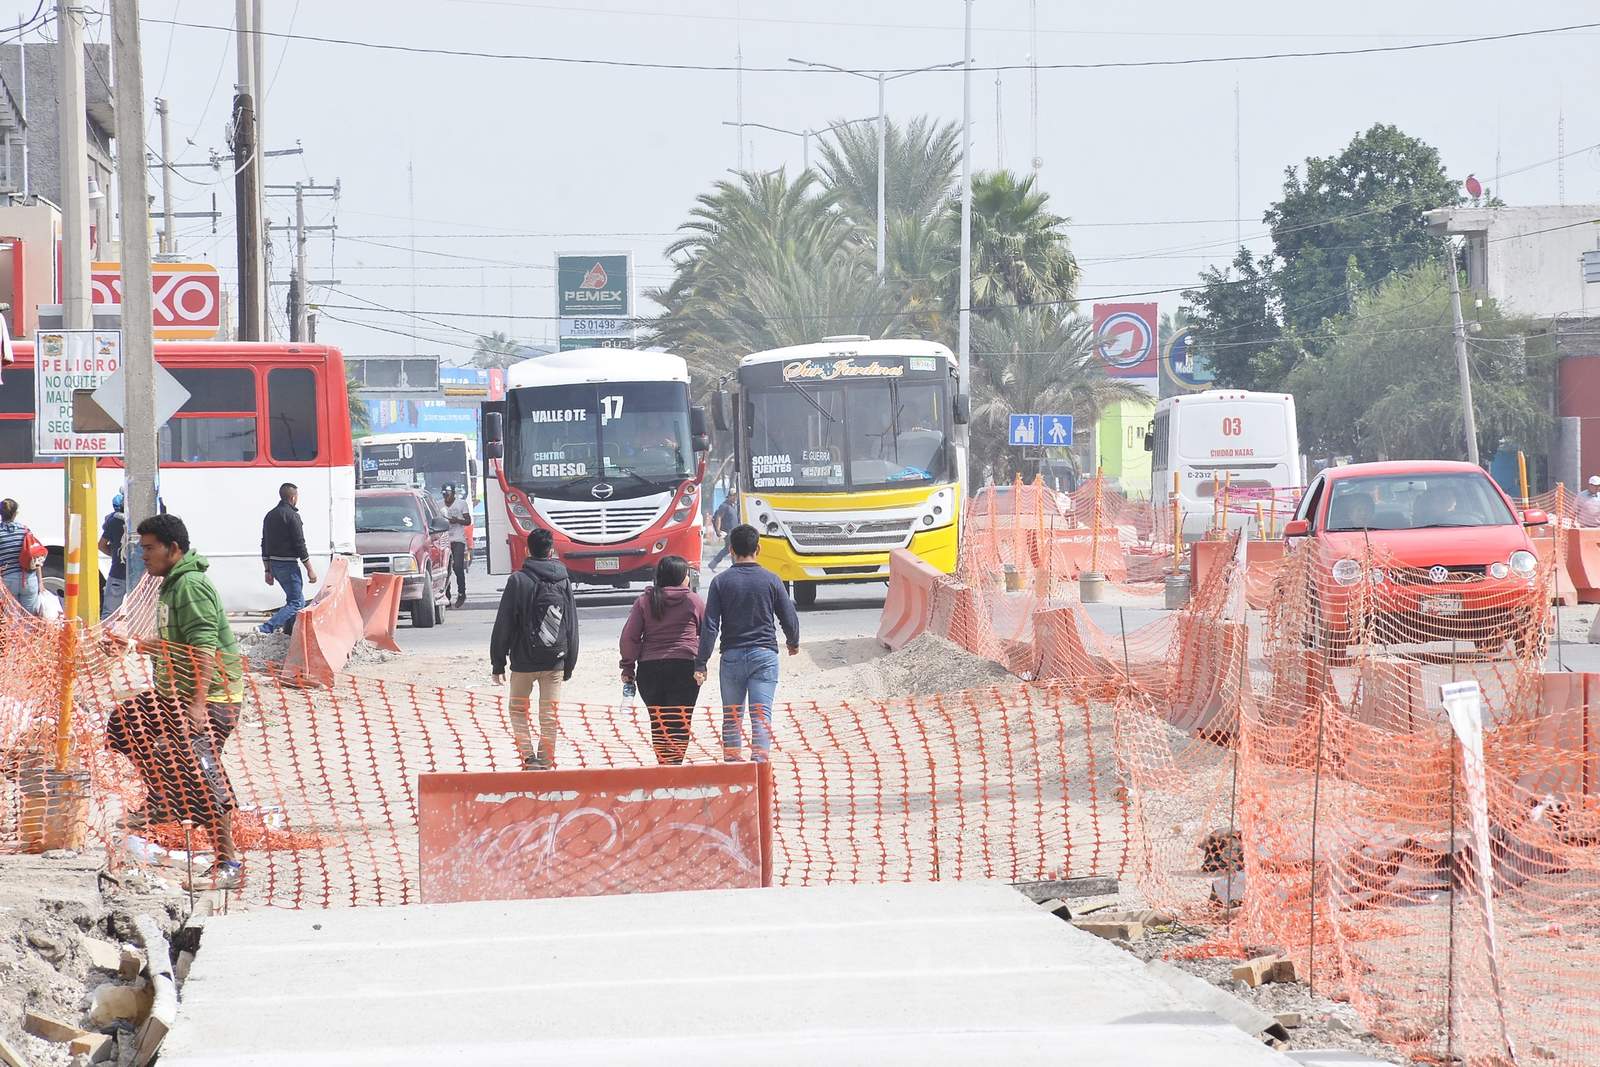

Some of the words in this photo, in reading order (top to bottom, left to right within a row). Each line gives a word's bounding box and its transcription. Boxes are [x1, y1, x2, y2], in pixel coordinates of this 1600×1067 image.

[92, 274, 214, 321] XO
[564, 291, 622, 301] PEMEX
[574, 320, 586, 329] ES
[588, 320, 615, 329] 01498
[42, 360, 117, 372] PELIGRO
[45, 376, 61, 387] NO
[64, 376, 97, 388] QUITE
[600, 396, 624, 420] 17
[532, 410, 564, 423] VALLE
[1222, 417, 1242, 436] 03
[54, 438, 71, 450] NO
[75, 438, 106, 450] PASE
[396, 443, 413, 459] 10
[534, 451, 565, 461] CENTRO
[752, 454, 791, 465] SORIANA
[532, 463, 587, 477] CERESO
[752, 464, 792, 473] FUENTES
[753, 478, 775, 487] CENTRO
